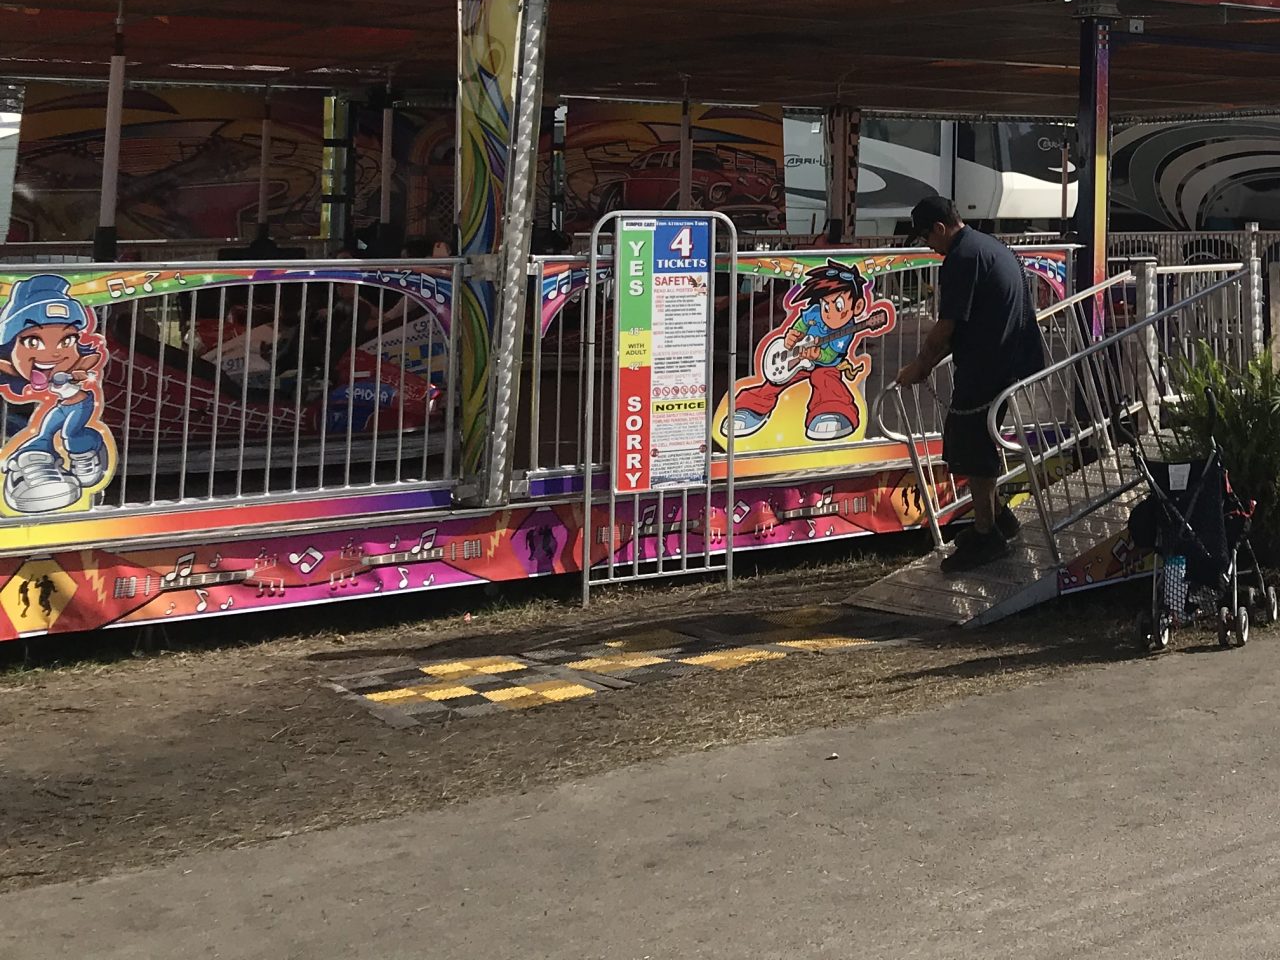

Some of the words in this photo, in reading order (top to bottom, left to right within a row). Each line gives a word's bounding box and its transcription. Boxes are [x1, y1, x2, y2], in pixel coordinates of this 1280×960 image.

[669, 227, 694, 258] 4
[628, 240, 645, 296] YES
[656, 258, 707, 268] TICKETS
[654, 275, 694, 286] SAFETY
[655, 401, 705, 411] NOTICE
[625, 395, 643, 488] SORRY
